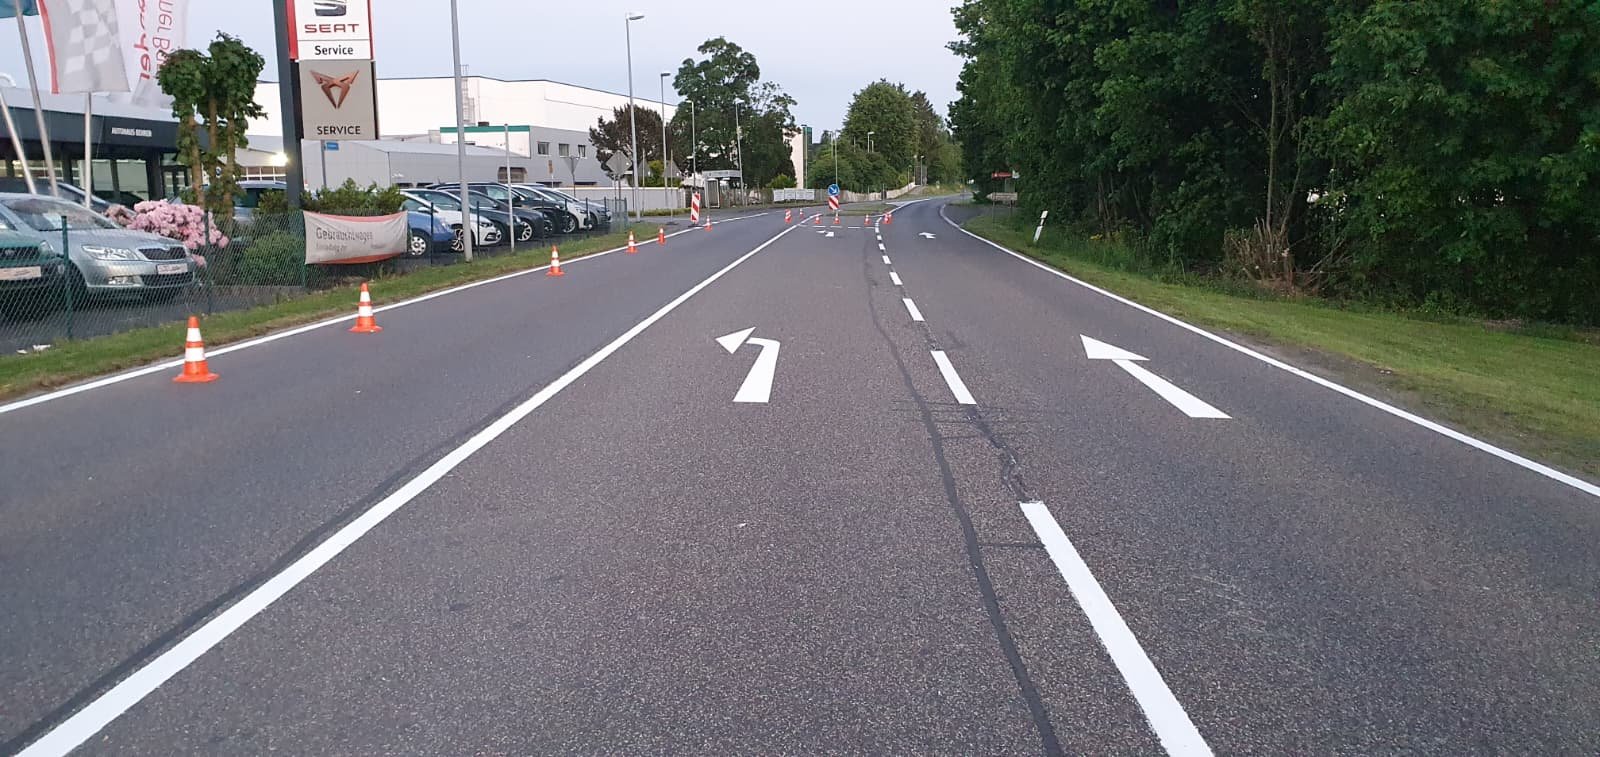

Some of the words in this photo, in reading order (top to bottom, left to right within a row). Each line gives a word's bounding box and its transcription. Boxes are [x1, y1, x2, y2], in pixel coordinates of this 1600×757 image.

[304, 23, 360, 33] SEAT
[314, 44, 354, 55] Service
[316, 125, 361, 135] SERVICE
